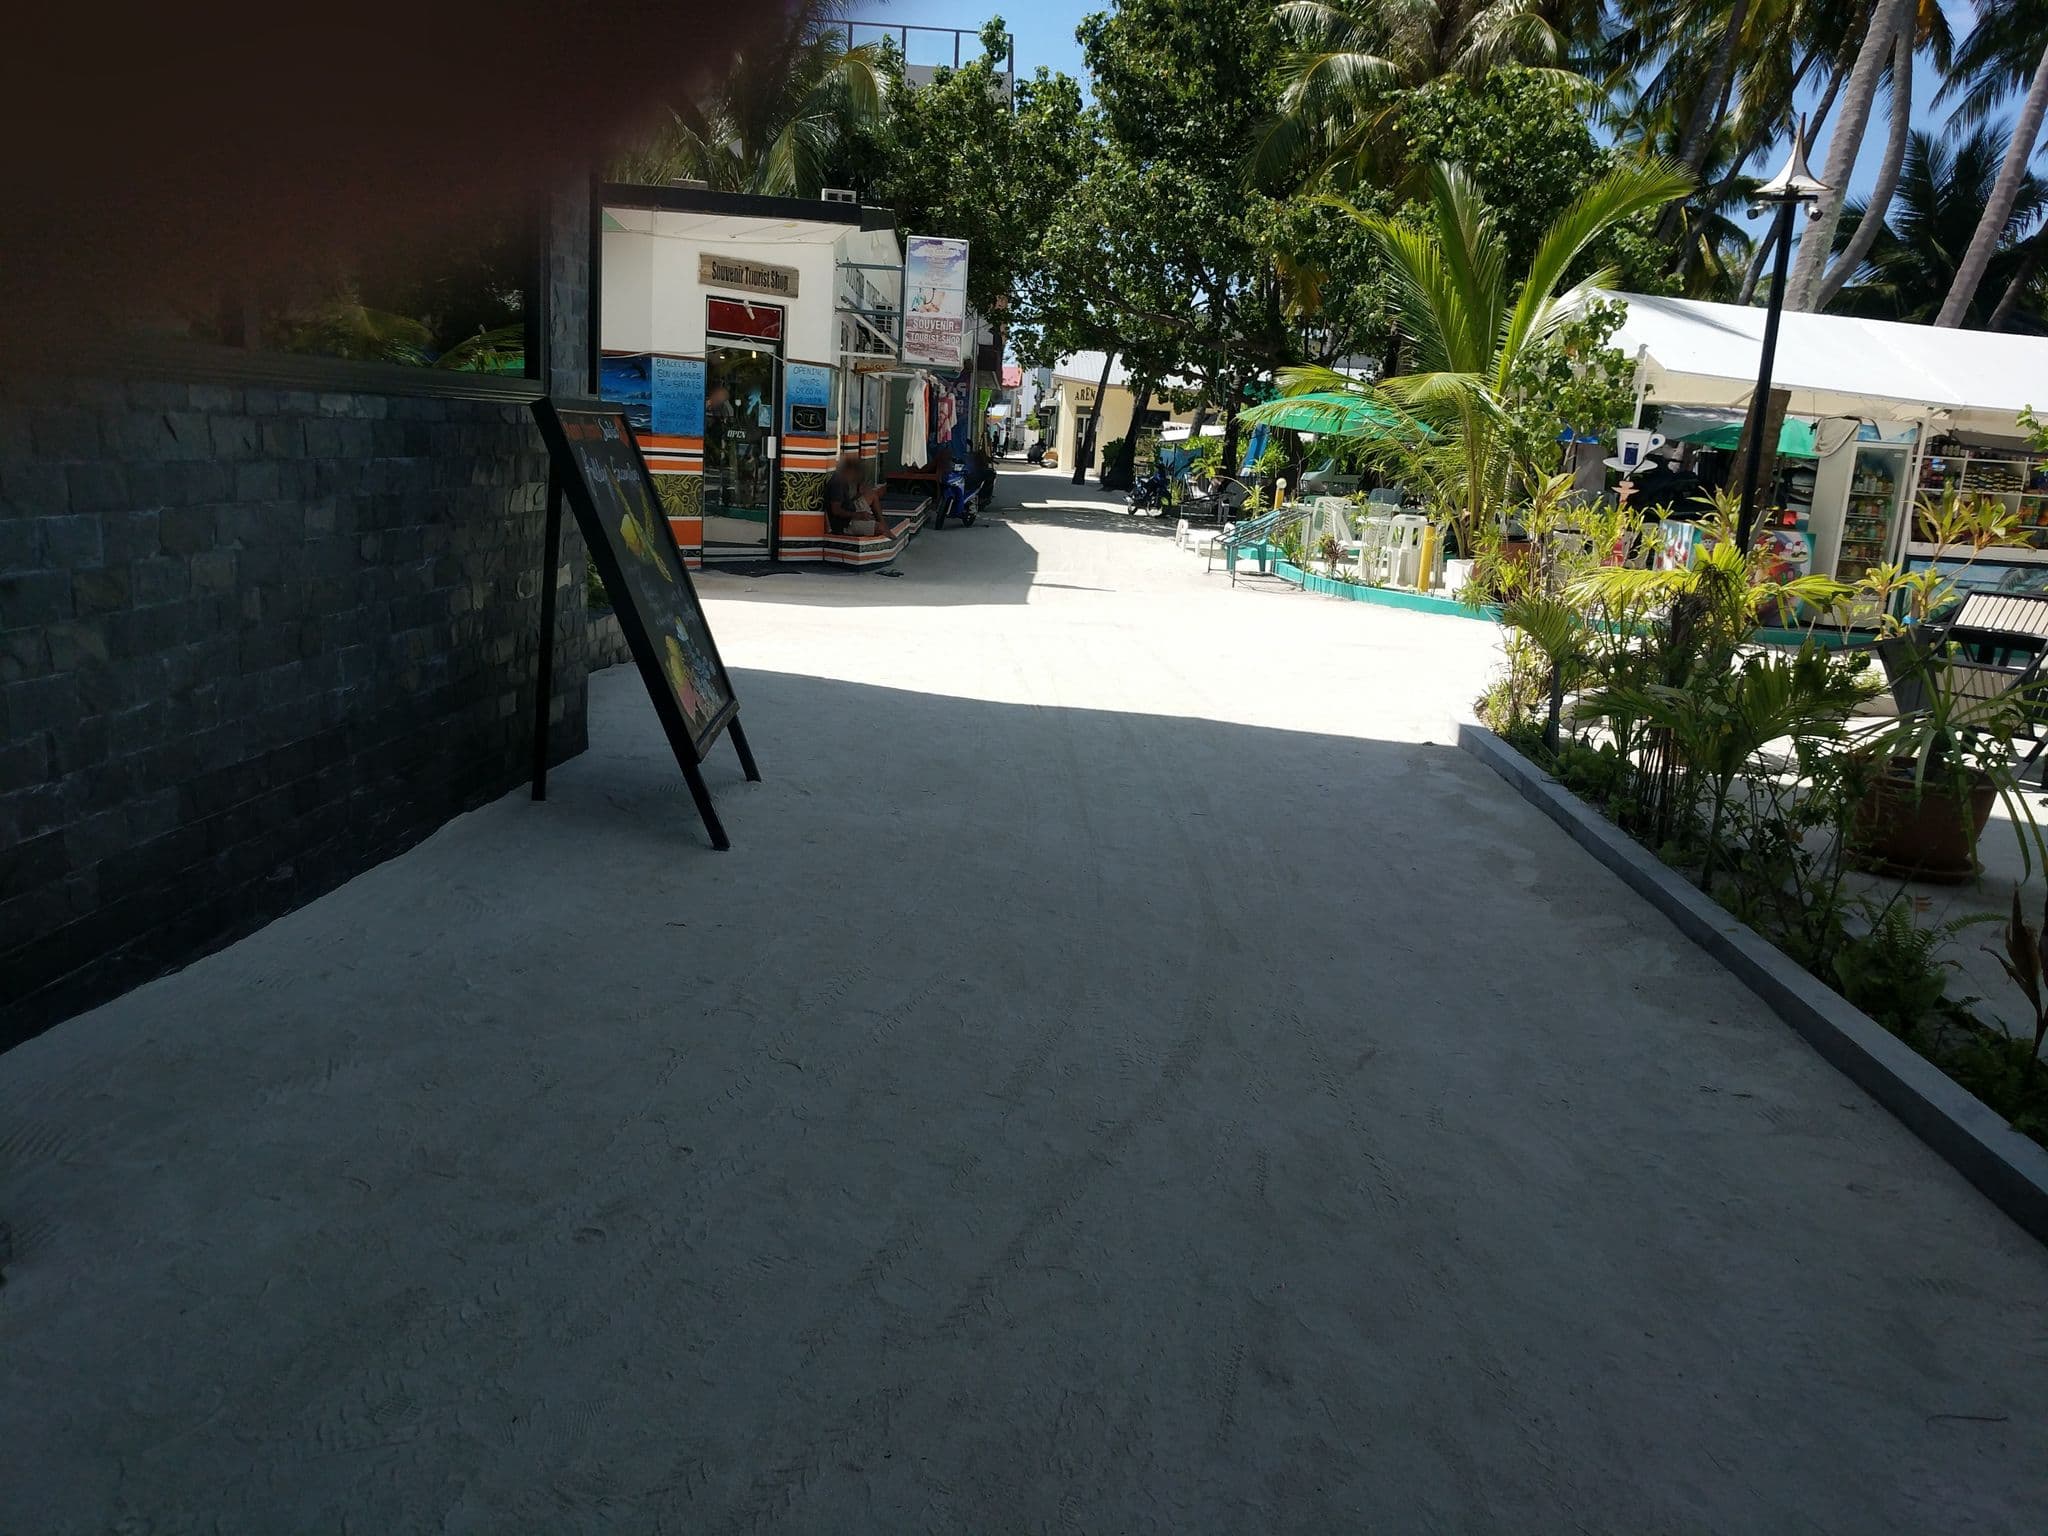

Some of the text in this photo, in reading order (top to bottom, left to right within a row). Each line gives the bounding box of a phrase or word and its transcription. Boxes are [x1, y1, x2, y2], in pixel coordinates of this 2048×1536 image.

[711, 260, 789, 292] Souvenir Tourist Shop
[912, 319, 955, 332] SOUVENIR
[910, 332, 961, 346] TOURIST SHOP
[1074, 386, 1097, 400] AREN
